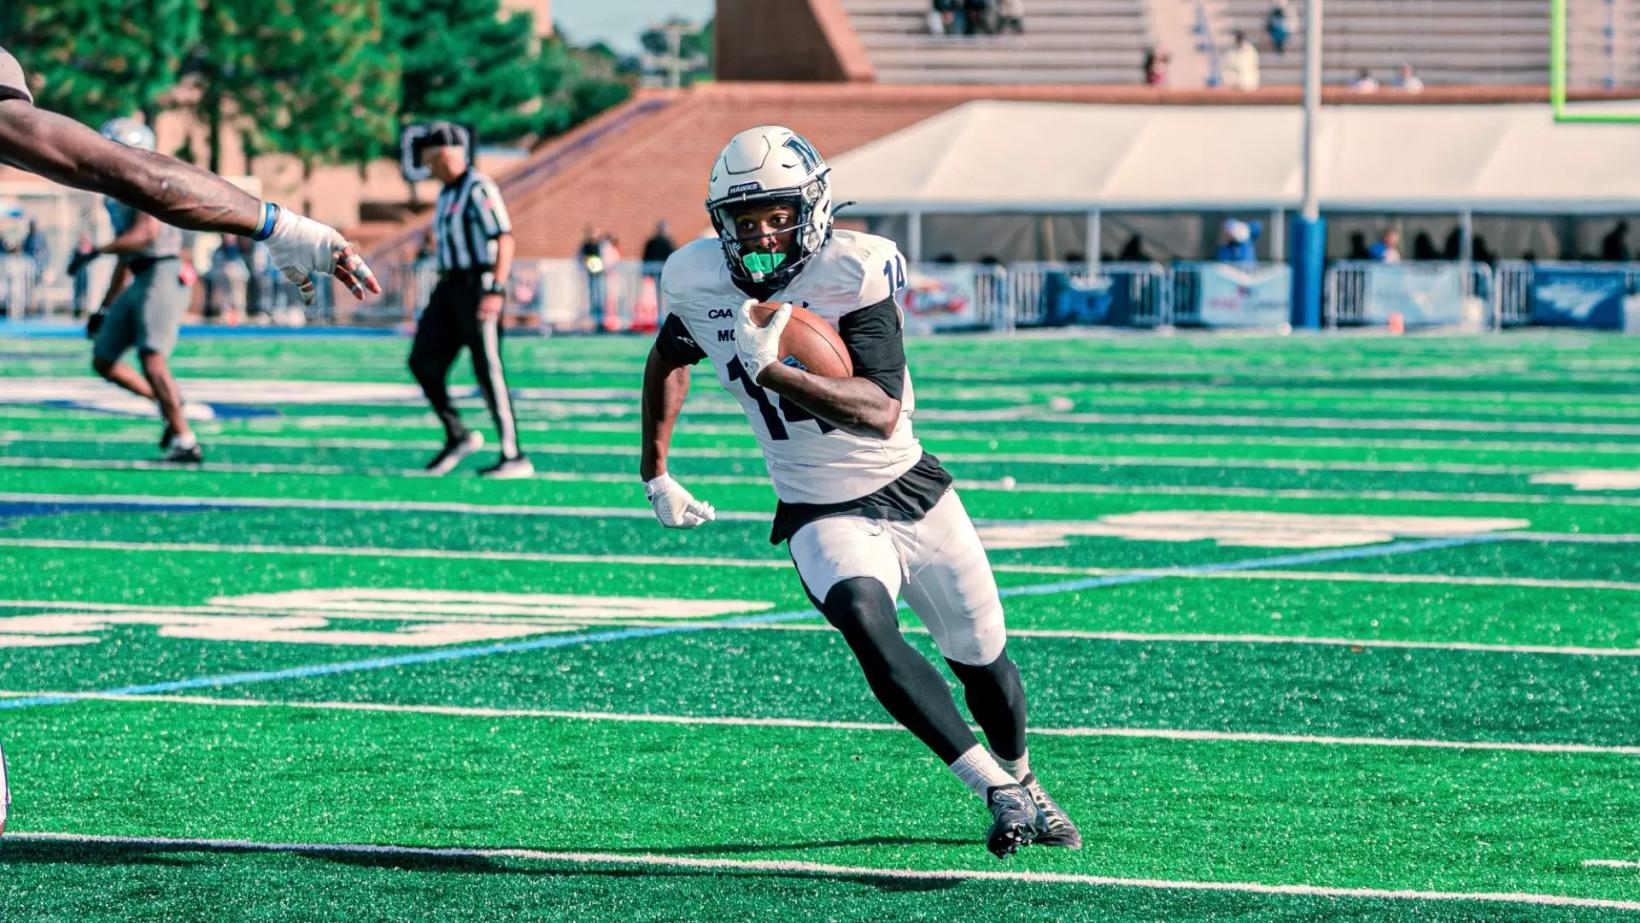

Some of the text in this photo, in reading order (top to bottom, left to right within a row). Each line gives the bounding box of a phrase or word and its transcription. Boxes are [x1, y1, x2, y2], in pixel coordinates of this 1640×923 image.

[782, 134, 823, 176] M
[730, 183, 758, 193] HAWKS
[883, 254, 905, 296] 14
[708, 308, 733, 319] CAA
